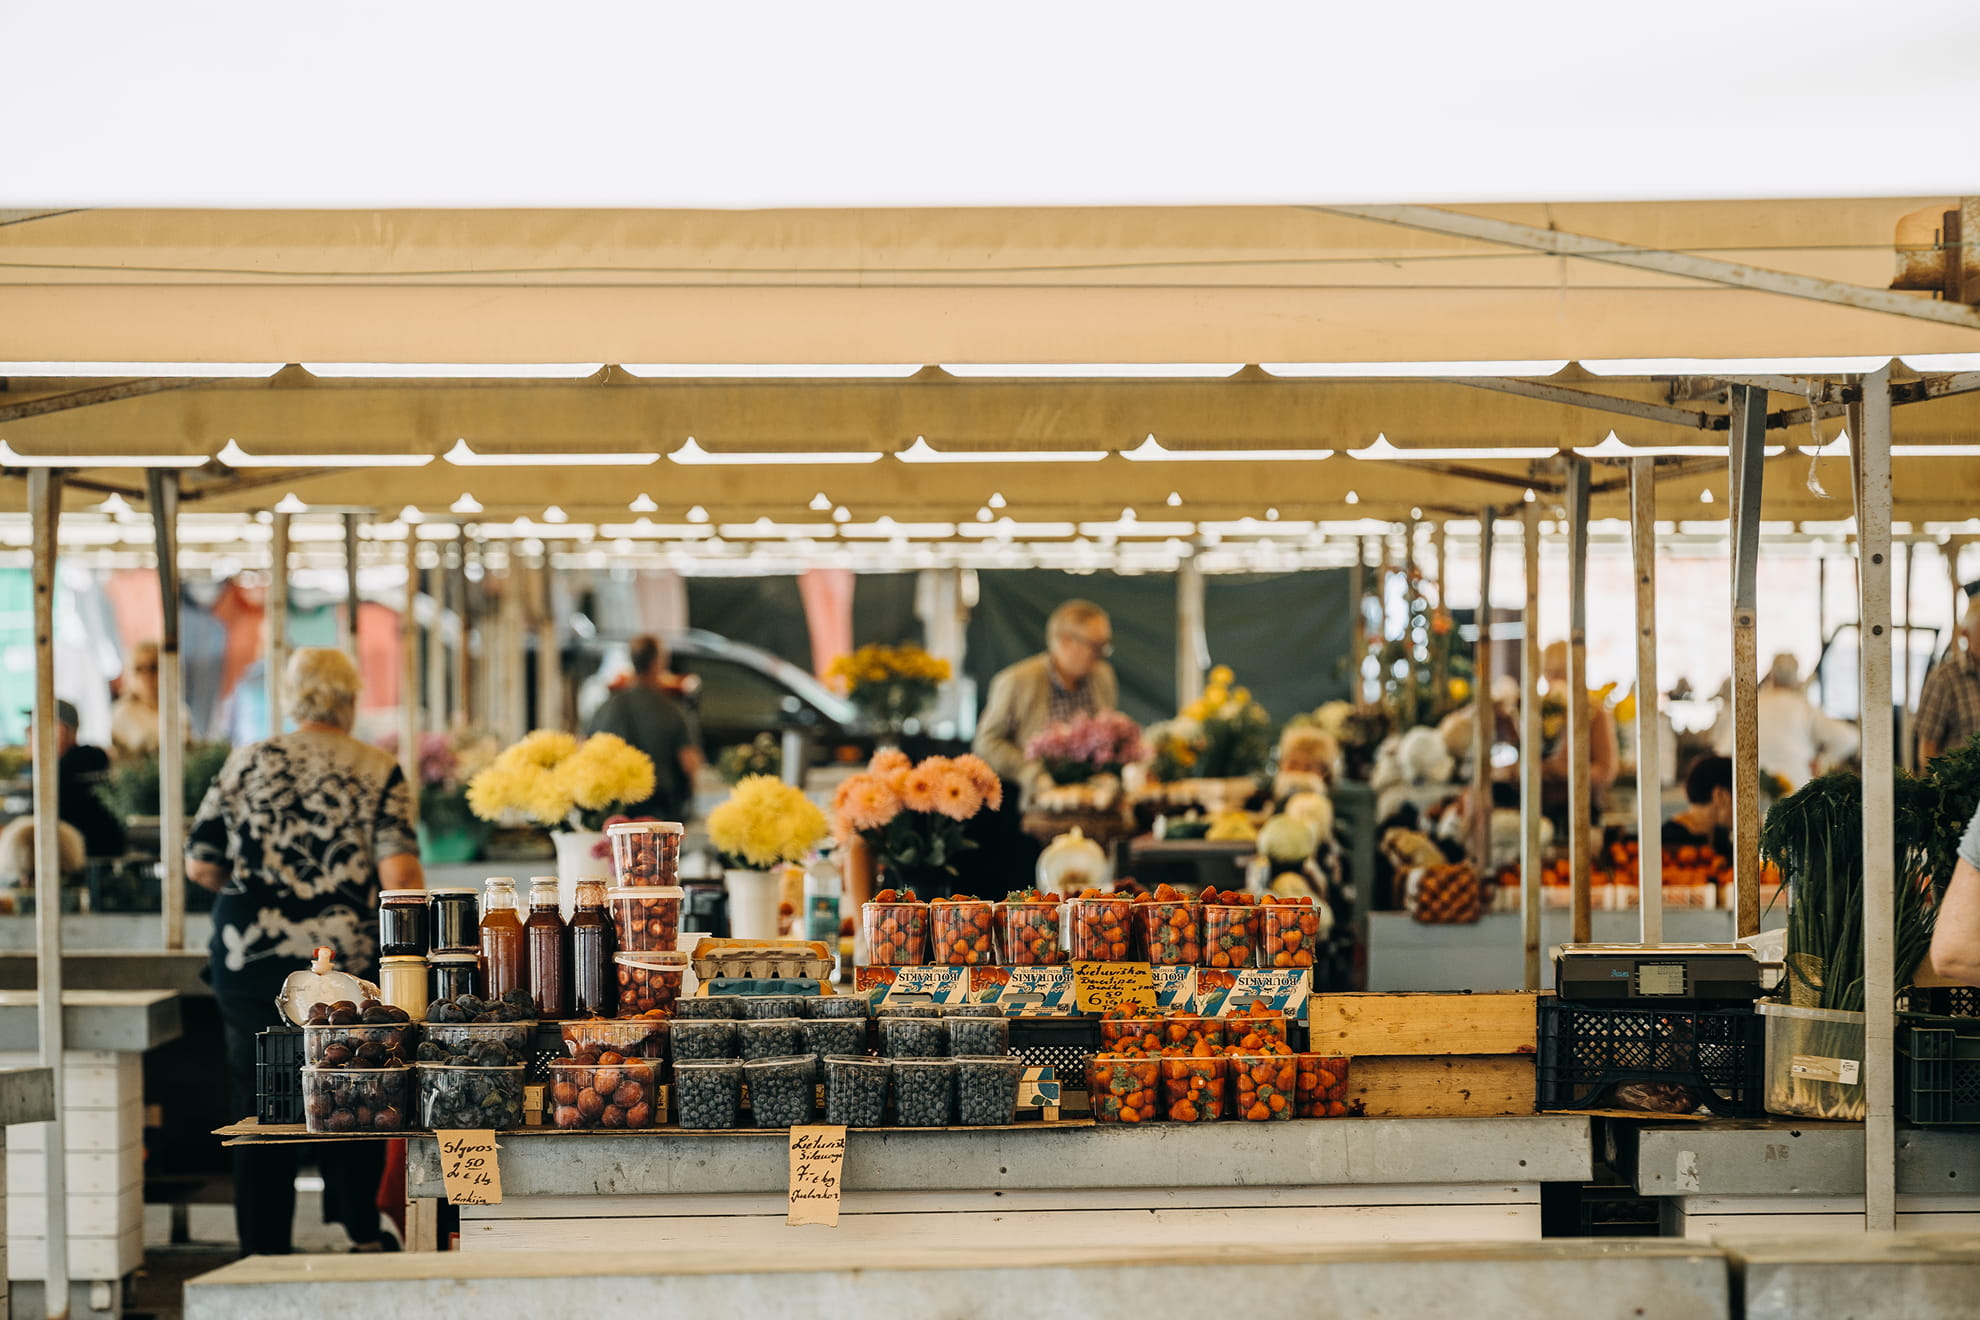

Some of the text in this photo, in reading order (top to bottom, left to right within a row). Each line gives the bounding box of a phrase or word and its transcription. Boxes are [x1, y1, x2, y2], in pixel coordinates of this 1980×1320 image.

[898, 973, 957, 981] BOURAKIS
[1012, 974, 1071, 982] BOURAKIS
[1238, 977, 1297, 985] BOURAKIS
[1088, 992, 1102, 1005] 6
[443, 1138, 493, 1158] Slyvos
[446, 1162, 461, 1178] 2
[464, 1158, 485, 1169] 50
